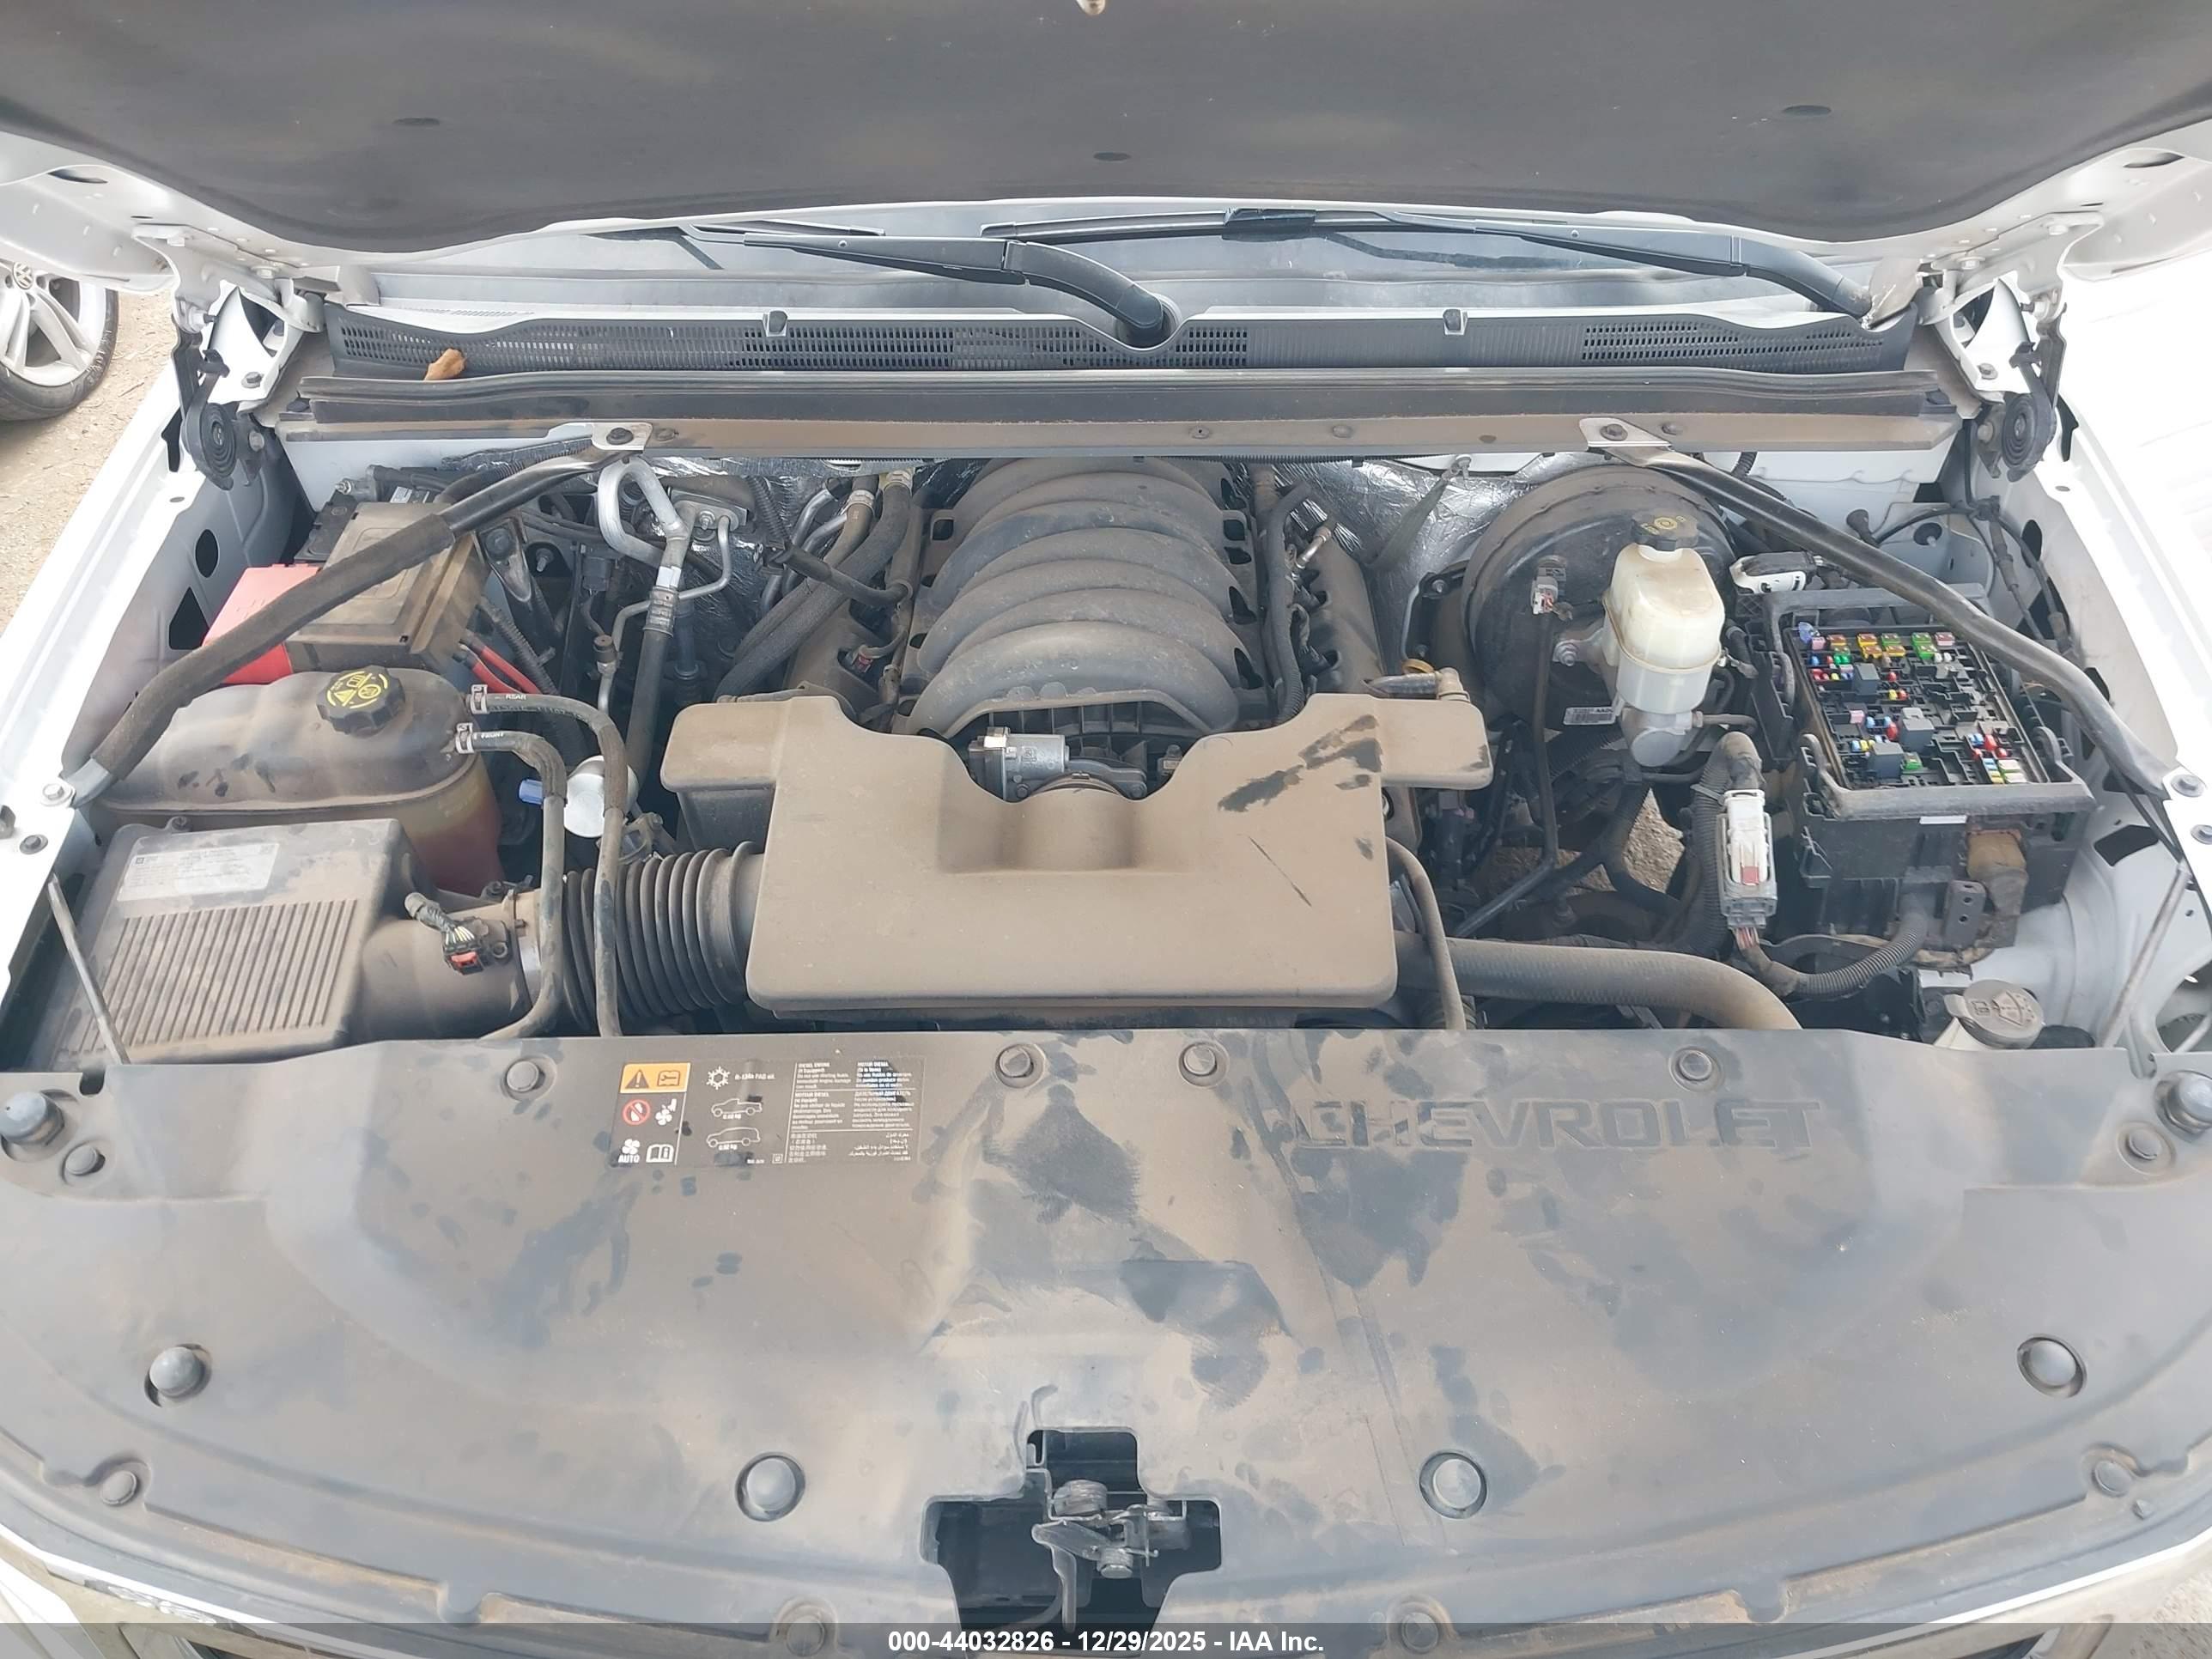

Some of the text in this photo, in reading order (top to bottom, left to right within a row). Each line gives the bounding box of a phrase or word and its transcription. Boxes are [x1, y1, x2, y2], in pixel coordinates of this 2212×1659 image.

[480, 731, 504, 739] FRONT
[1296, 1098, 1820, 1151] CHEVROLET
[617, 1154, 640, 1164] AUTO
